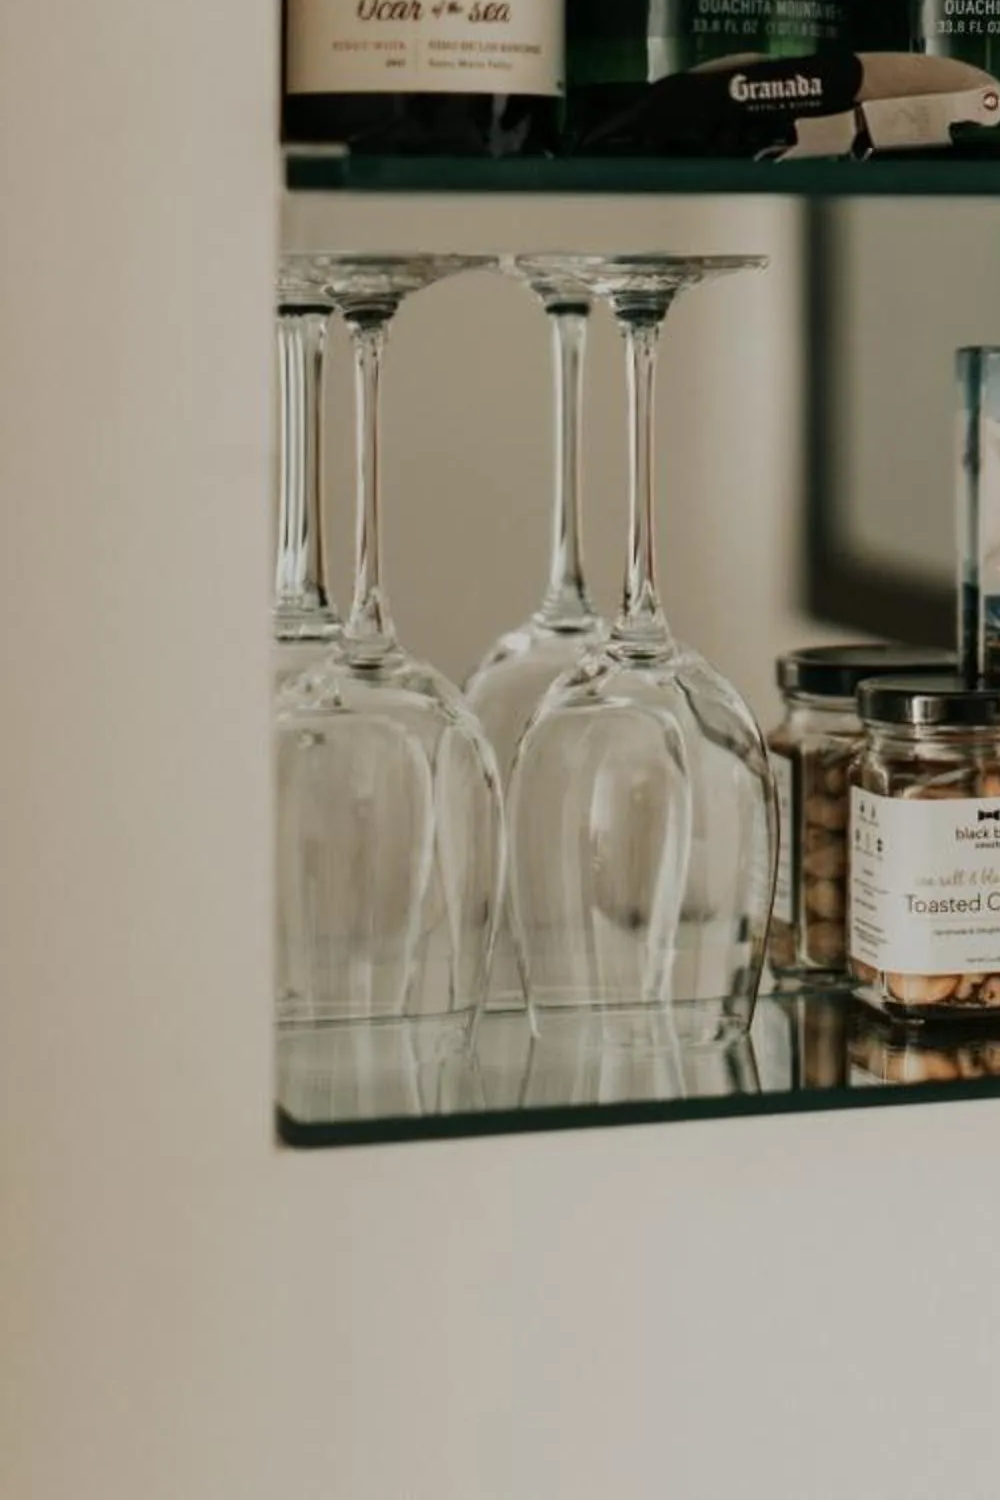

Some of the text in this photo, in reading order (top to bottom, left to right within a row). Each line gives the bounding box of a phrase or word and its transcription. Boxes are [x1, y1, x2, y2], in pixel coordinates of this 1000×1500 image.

[468, 0, 511, 23] sea
[969, 20, 984, 34] FL
[728, 73, 822, 101] Granada
[955, 826, 988, 840] black
[905, 891, 981, 914] Toasted
